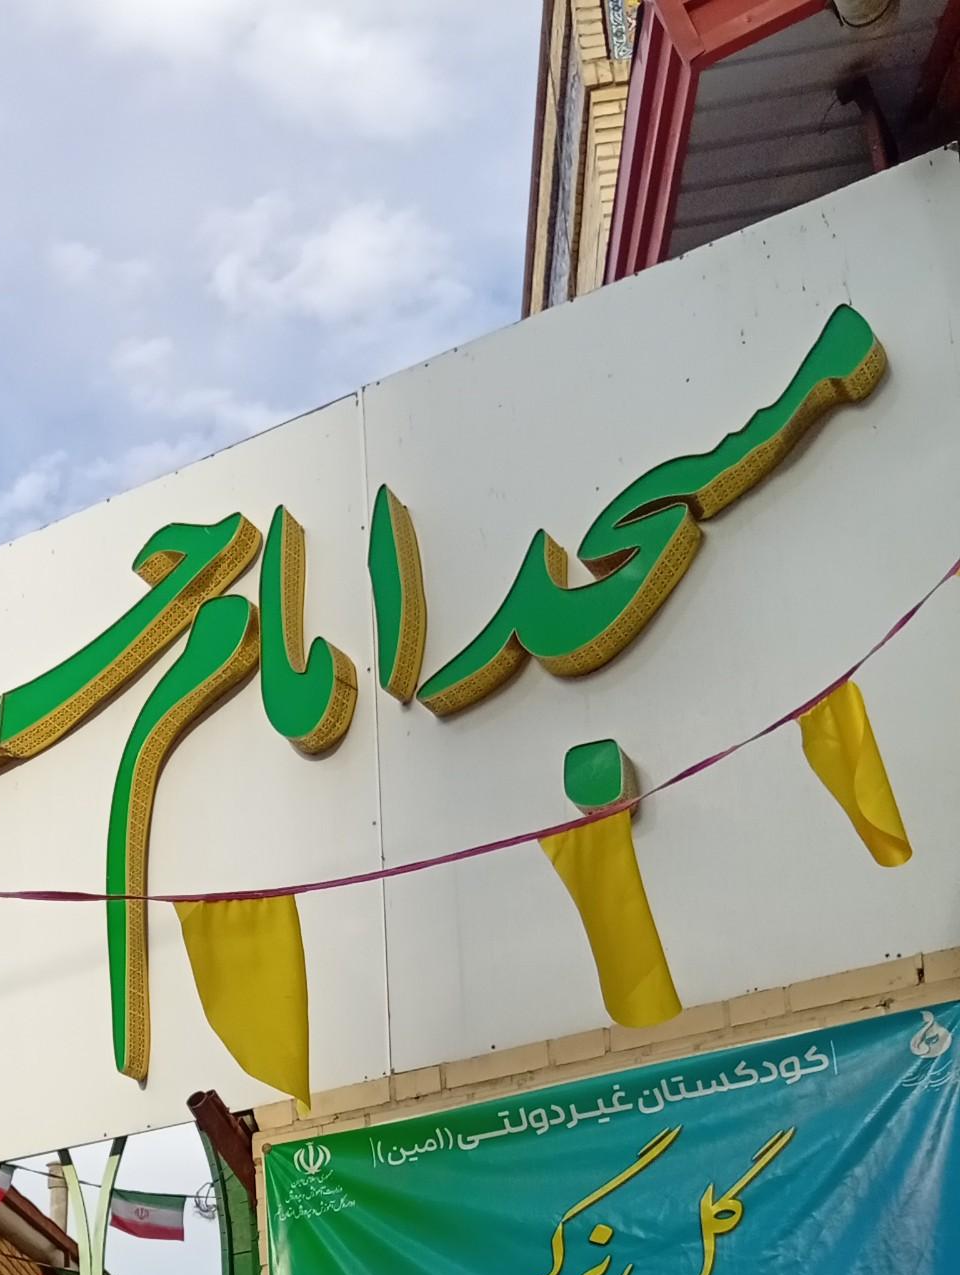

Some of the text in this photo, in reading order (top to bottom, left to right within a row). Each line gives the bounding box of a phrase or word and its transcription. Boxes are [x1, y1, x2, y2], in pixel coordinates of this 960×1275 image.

[105, 483, 429, 1083] امام
[416, 303, 887, 816] مسجد
[637, 1044, 831, 1115] کودکستان
